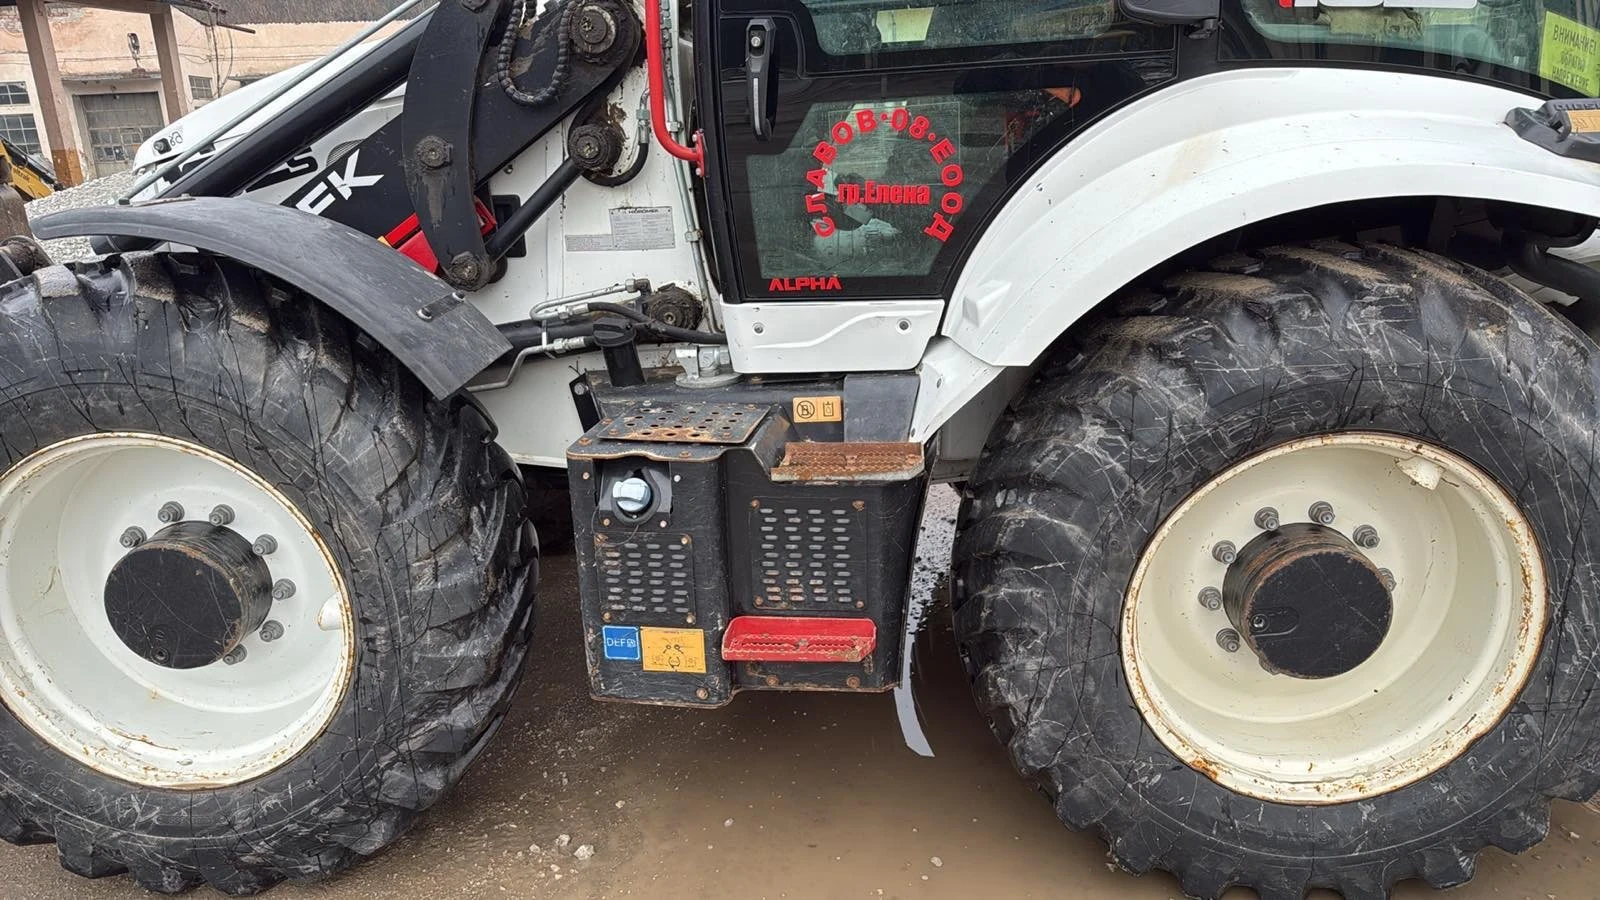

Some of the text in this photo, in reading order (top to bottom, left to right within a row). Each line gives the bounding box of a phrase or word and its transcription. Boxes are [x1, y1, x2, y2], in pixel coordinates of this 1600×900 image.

[837, 180, 930, 205] гр.Елена
[769, 277, 842, 291] ALPHA
[606, 638, 626, 647] DEF
